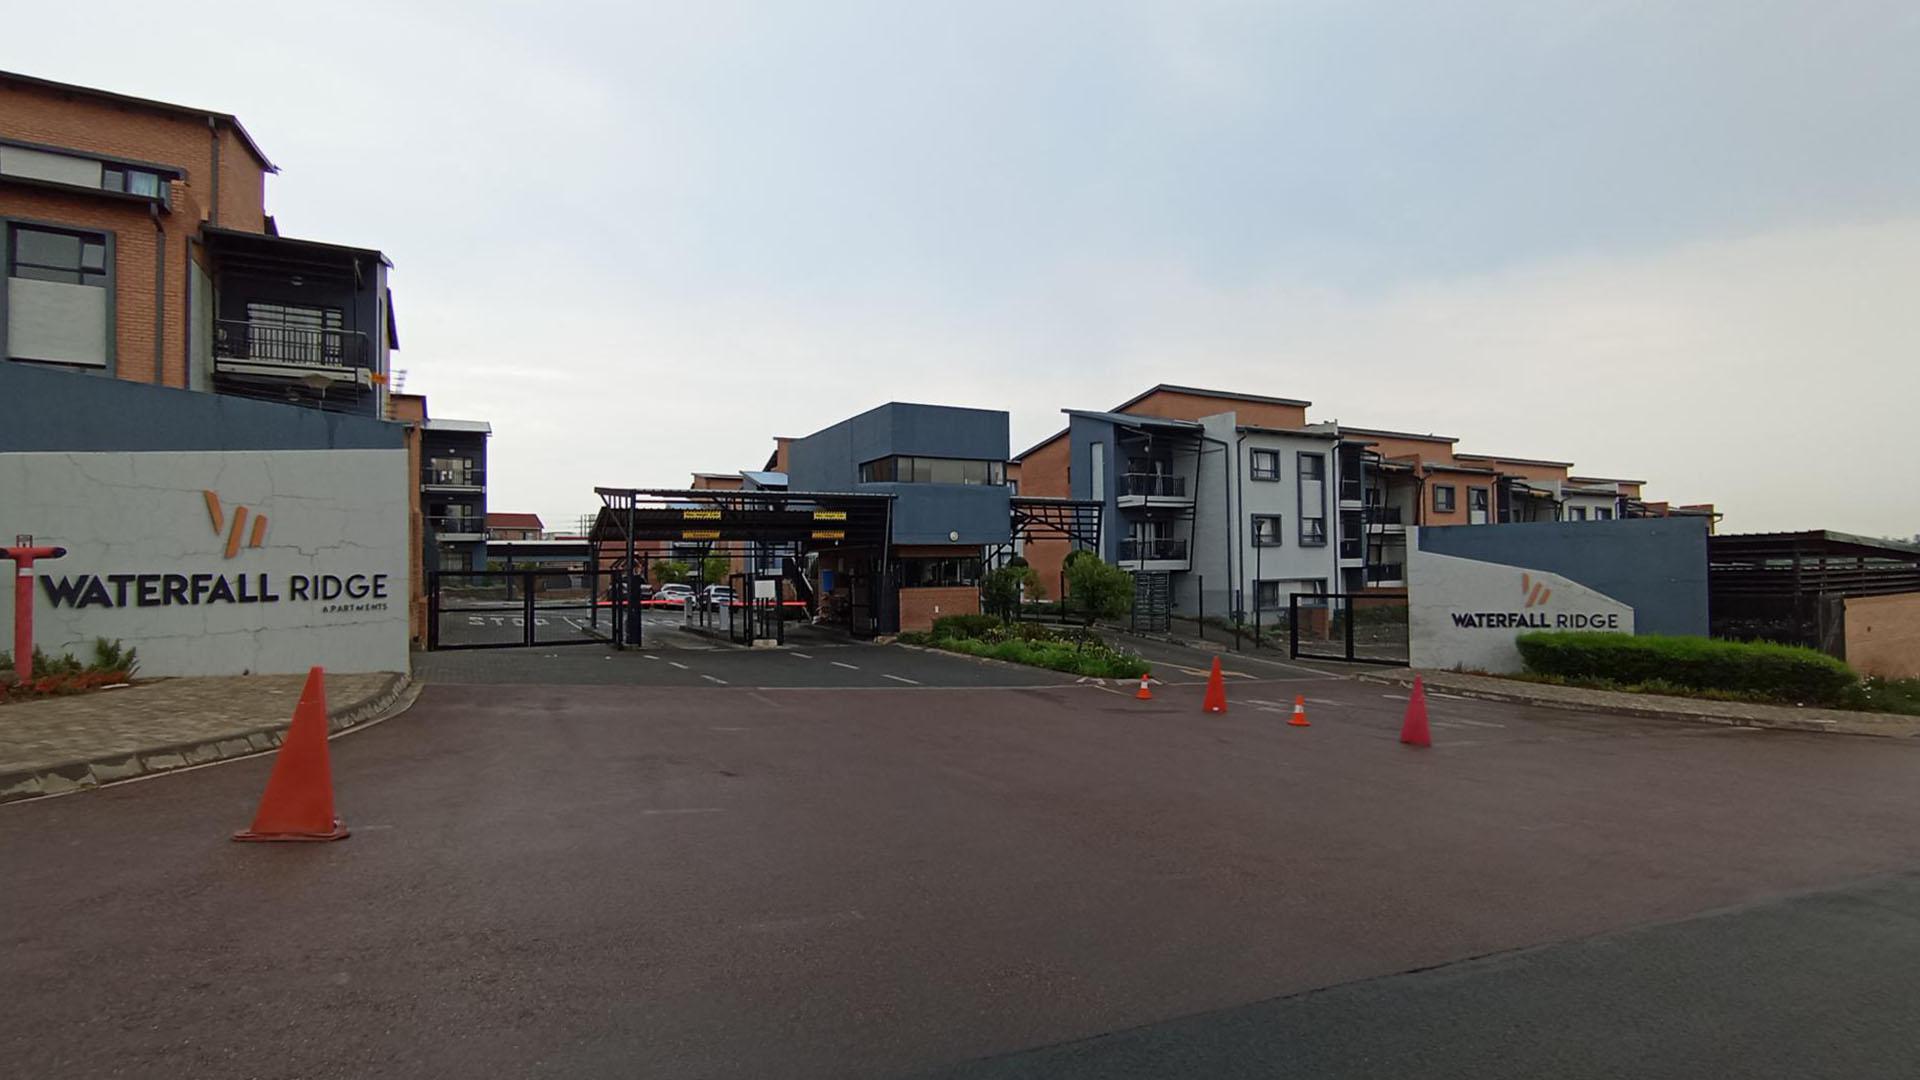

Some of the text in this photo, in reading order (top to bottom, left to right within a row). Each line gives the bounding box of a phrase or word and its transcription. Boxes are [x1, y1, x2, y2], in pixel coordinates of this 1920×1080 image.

[39, 573, 389, 609] WATERFALL RIDGE
[322, 602, 389, 613] APARTMENTS
[1451, 613, 1619, 629] WATERFALL RIDGE
